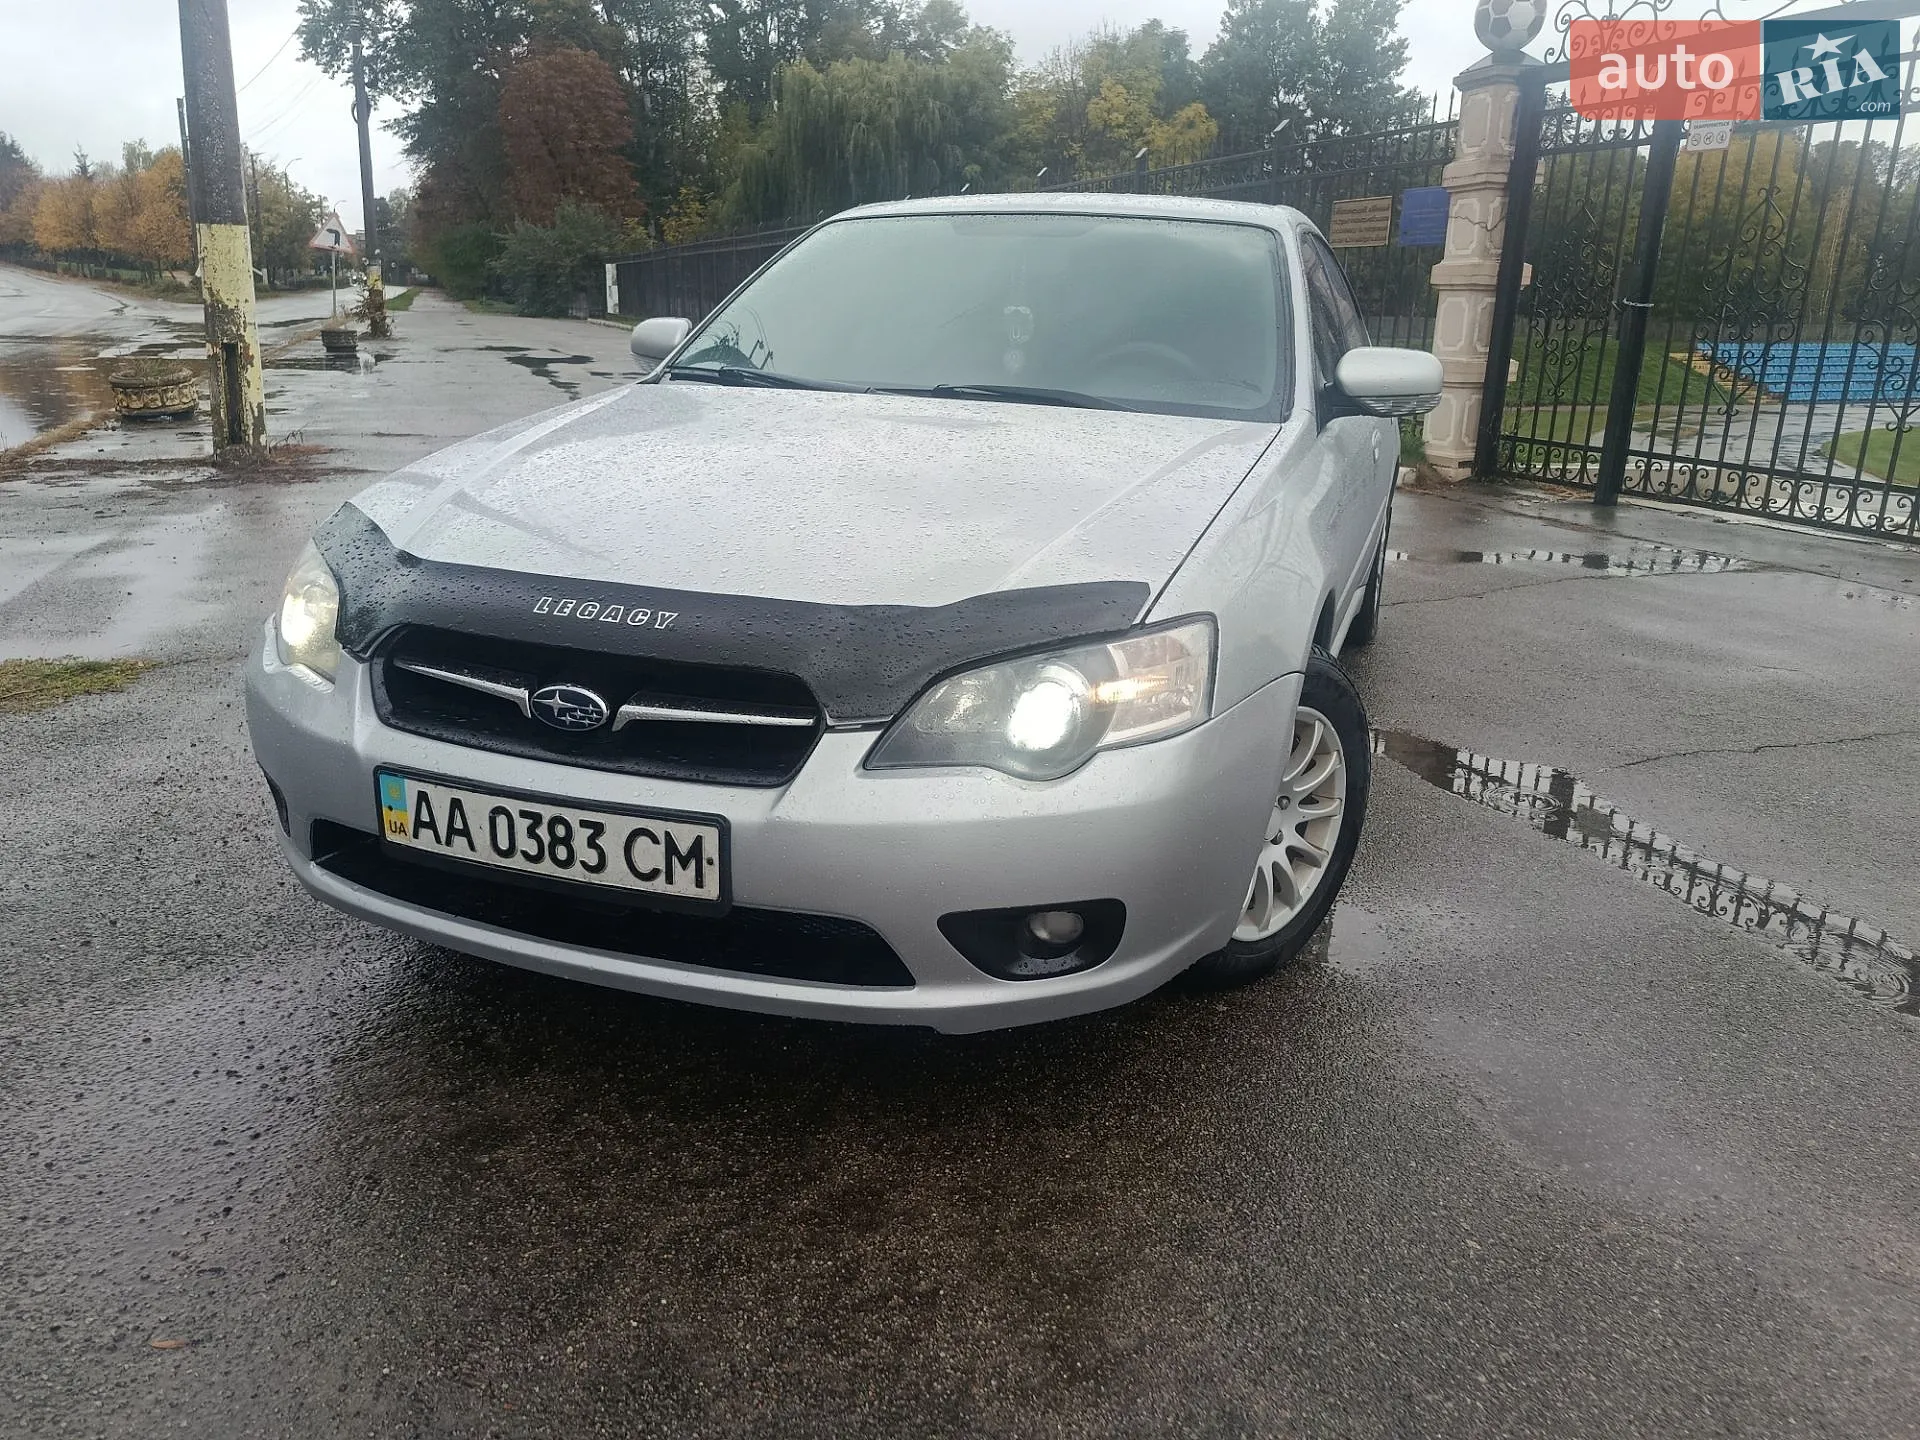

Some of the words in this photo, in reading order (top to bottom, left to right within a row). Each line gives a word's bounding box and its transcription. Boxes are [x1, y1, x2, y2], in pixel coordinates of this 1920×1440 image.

[533, 597, 679, 629] LEGACY
[388, 819, 409, 837] UA
[412, 790, 477, 853] AA
[489, 805, 608, 874] 0383
[623, 827, 705, 889] CM
